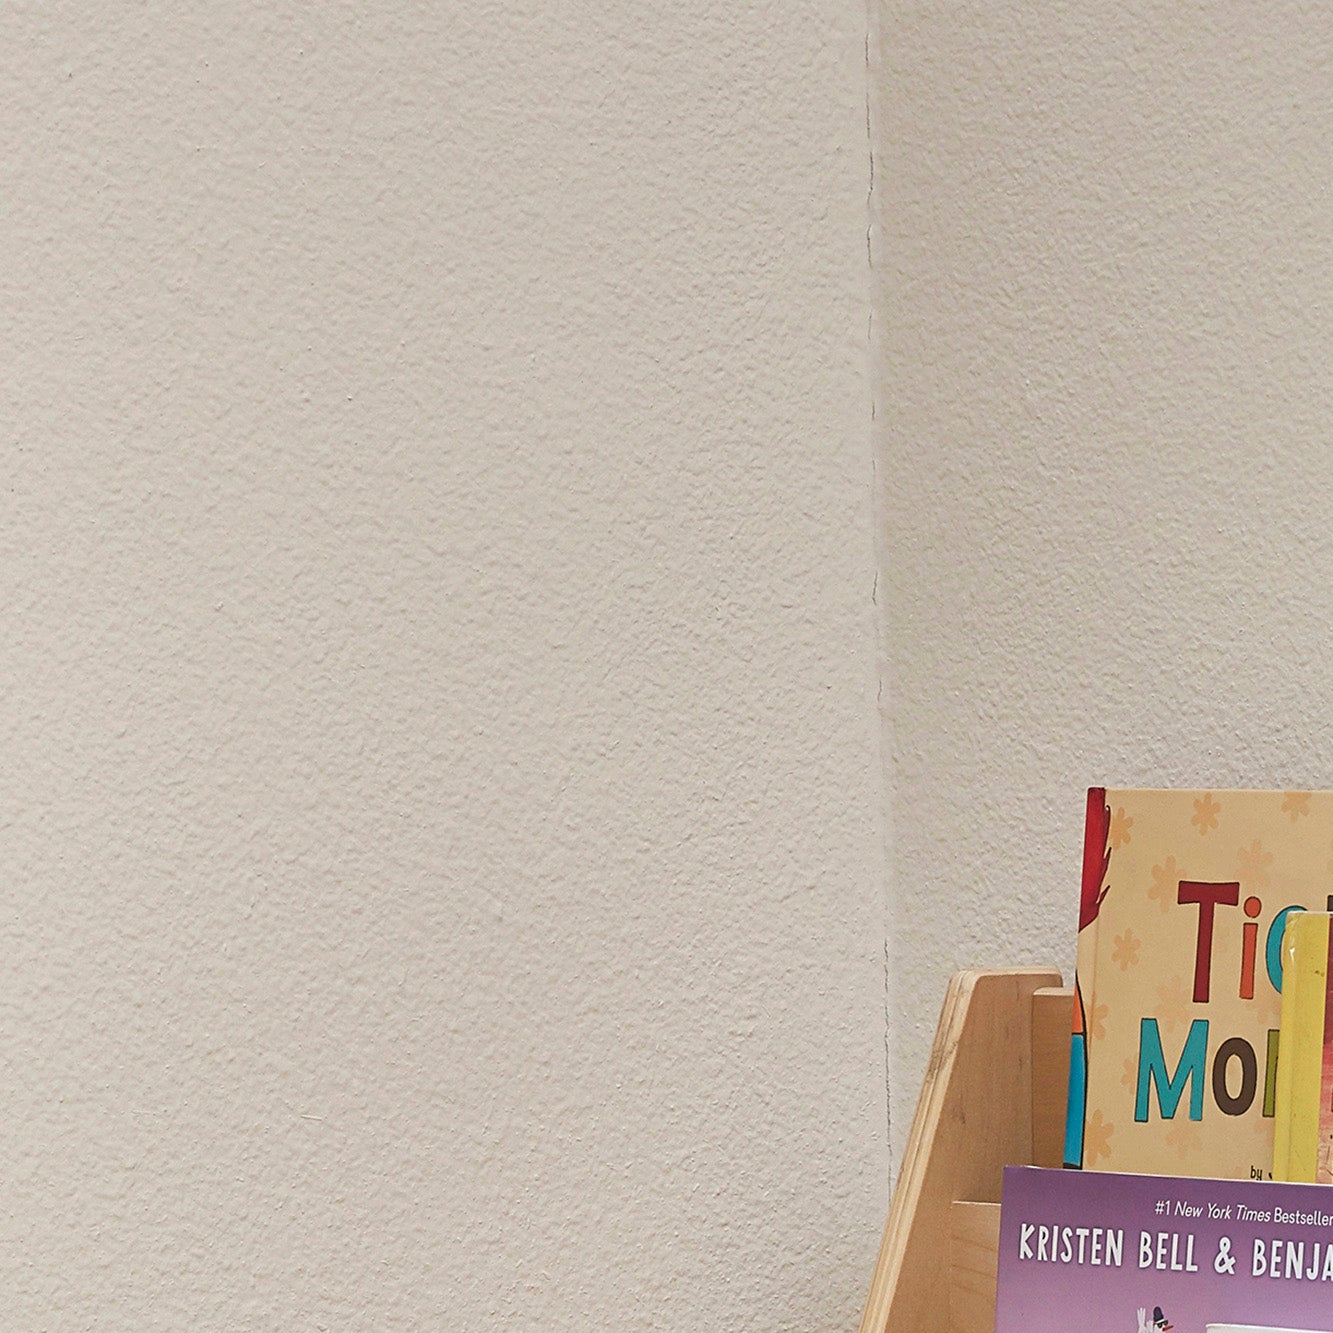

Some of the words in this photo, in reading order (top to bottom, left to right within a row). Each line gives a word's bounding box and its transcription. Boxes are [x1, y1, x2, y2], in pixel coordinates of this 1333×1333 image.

[1250, 1165, 1263, 1181] by
[1155, 1200, 1171, 1216] #1
[1174, 1201, 1204, 1218] New
[1207, 1202, 1232, 1220] York
[1236, 1204, 1271, 1222] Times
[1018, 1223, 1123, 1267] KRISTEN
[1139, 1231, 1198, 1272] BELL
[1214, 1236, 1237, 1275] &
